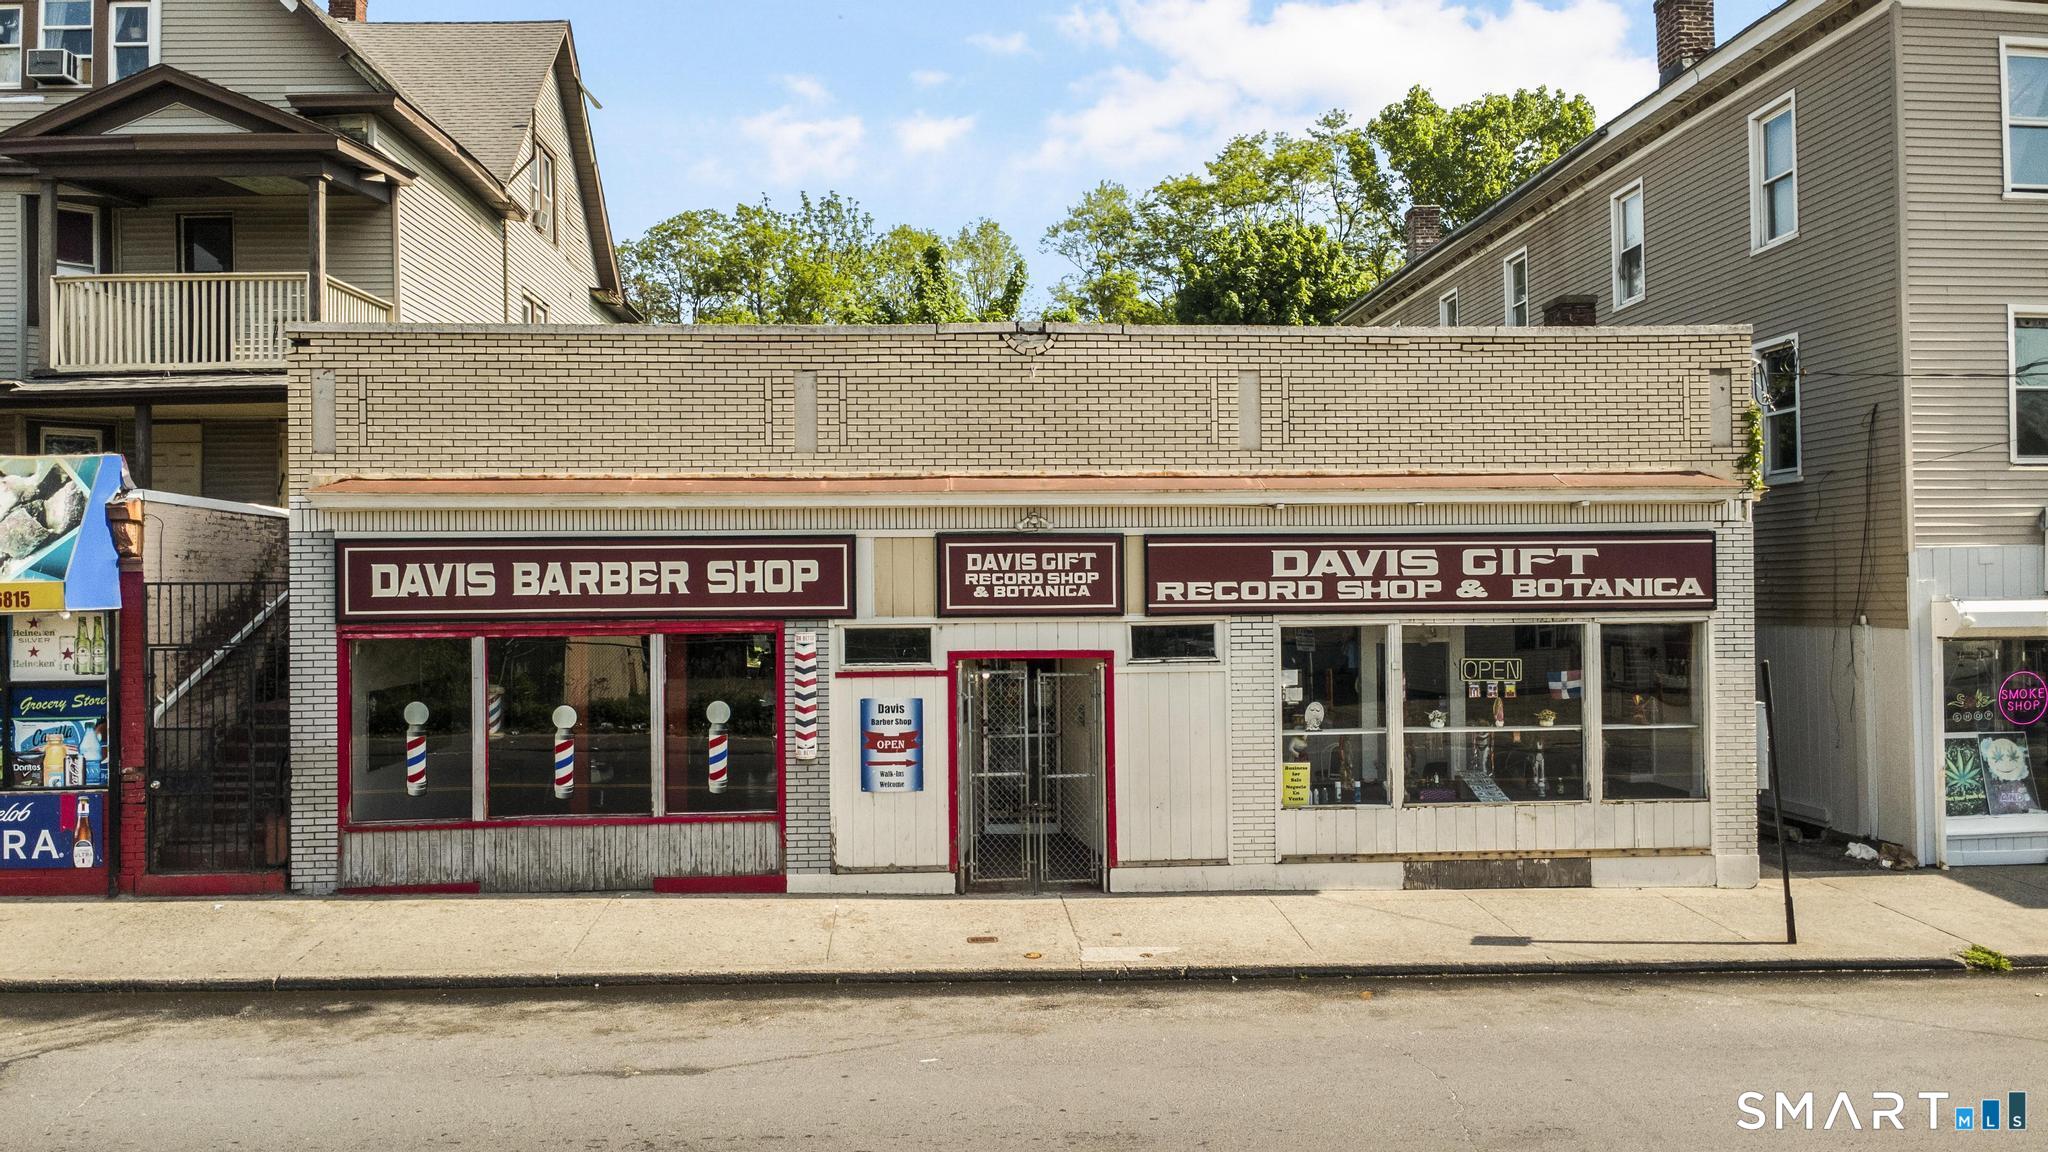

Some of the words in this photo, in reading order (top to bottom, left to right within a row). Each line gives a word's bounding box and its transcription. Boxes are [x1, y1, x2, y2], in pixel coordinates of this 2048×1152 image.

[966, 552, 1037, 571] DAVIS
[1041, 552, 1097, 570] GIFT
[1271, 548, 1439, 578] DAVIS
[1461, 547, 1599, 576] GIFT
[370, 562, 496, 598] DAVIS
[512, 560, 691, 596] BARBER
[706, 559, 819, 594] SHOP
[965, 572, 1044, 585] RECORD
[1047, 571, 1099, 584] SHOP
[973, 585, 989, 598] &
[993, 584, 1091, 598] BOTANICA
[1156, 580, 1323, 601] RECORD
[1337, 579, 1442, 600] SHOP
[1455, 579, 1488, 598] &
[1511, 577, 1705, 598] BOTANICA
[0, 590, 31, 608] 815
[1463, 660, 1520, 680] OPEN
[2001, 687, 2045, 700] SMOKE
[20, 696, 67, 716] Grocery
[72, 693, 107, 708] Store
[877, 703, 905, 714] Davis
[2007, 700, 2040, 711] SHOP
[871, 718, 894, 726] Barber
[895, 718, 912, 726] Shop
[877, 740, 905, 749] OPEN
[13, 763, 41, 771] Doritos
